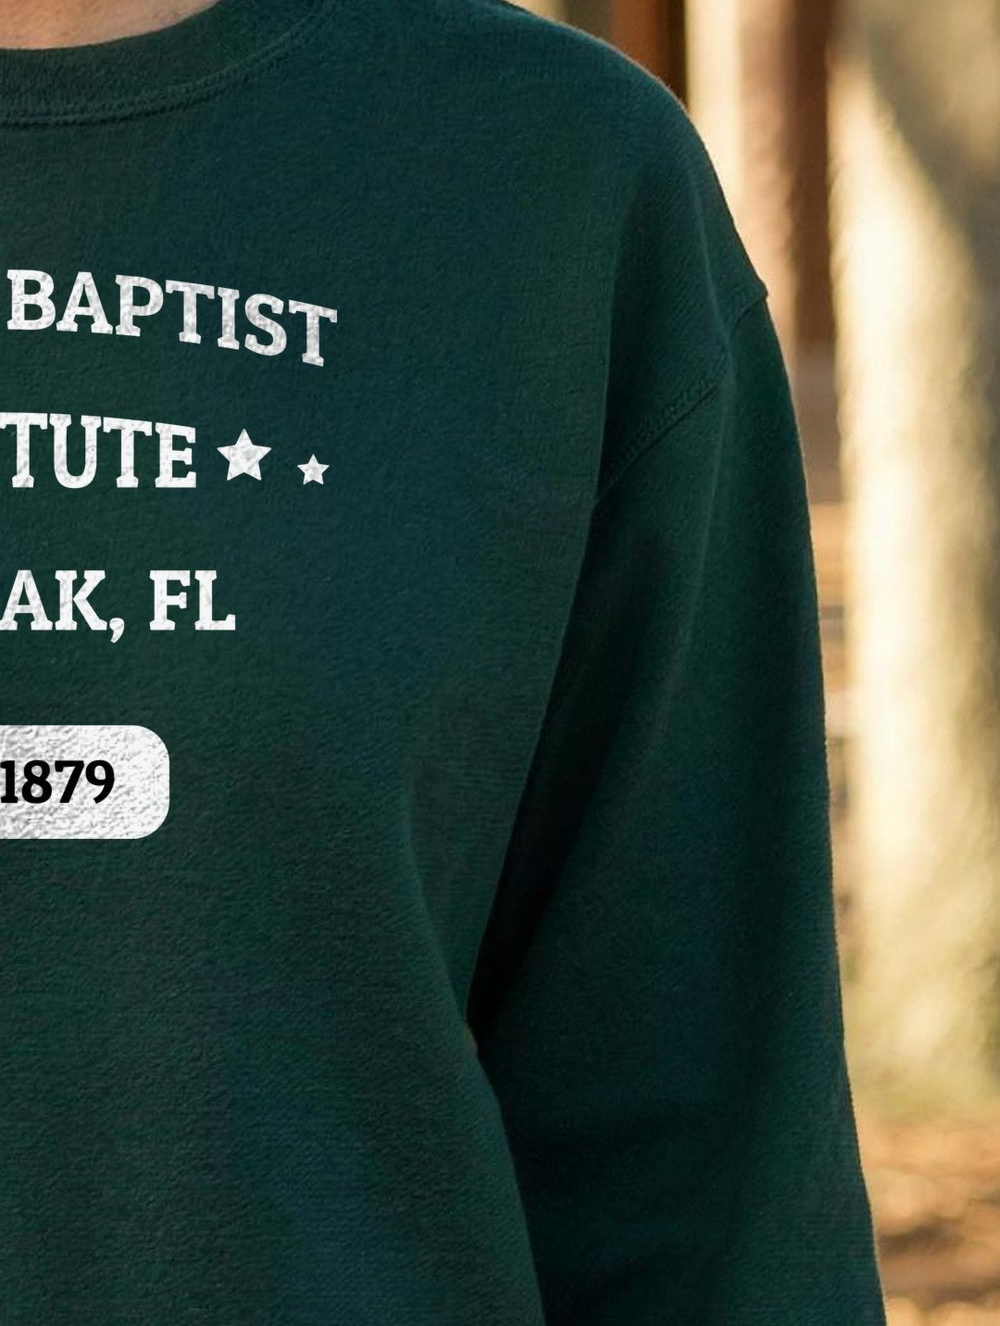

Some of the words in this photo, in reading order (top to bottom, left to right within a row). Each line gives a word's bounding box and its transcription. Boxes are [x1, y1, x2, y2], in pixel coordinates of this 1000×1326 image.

[6, 268, 338, 367] BAPTIST
[149, 569, 236, 631] FL
[0, 759, 115, 804] 1879
